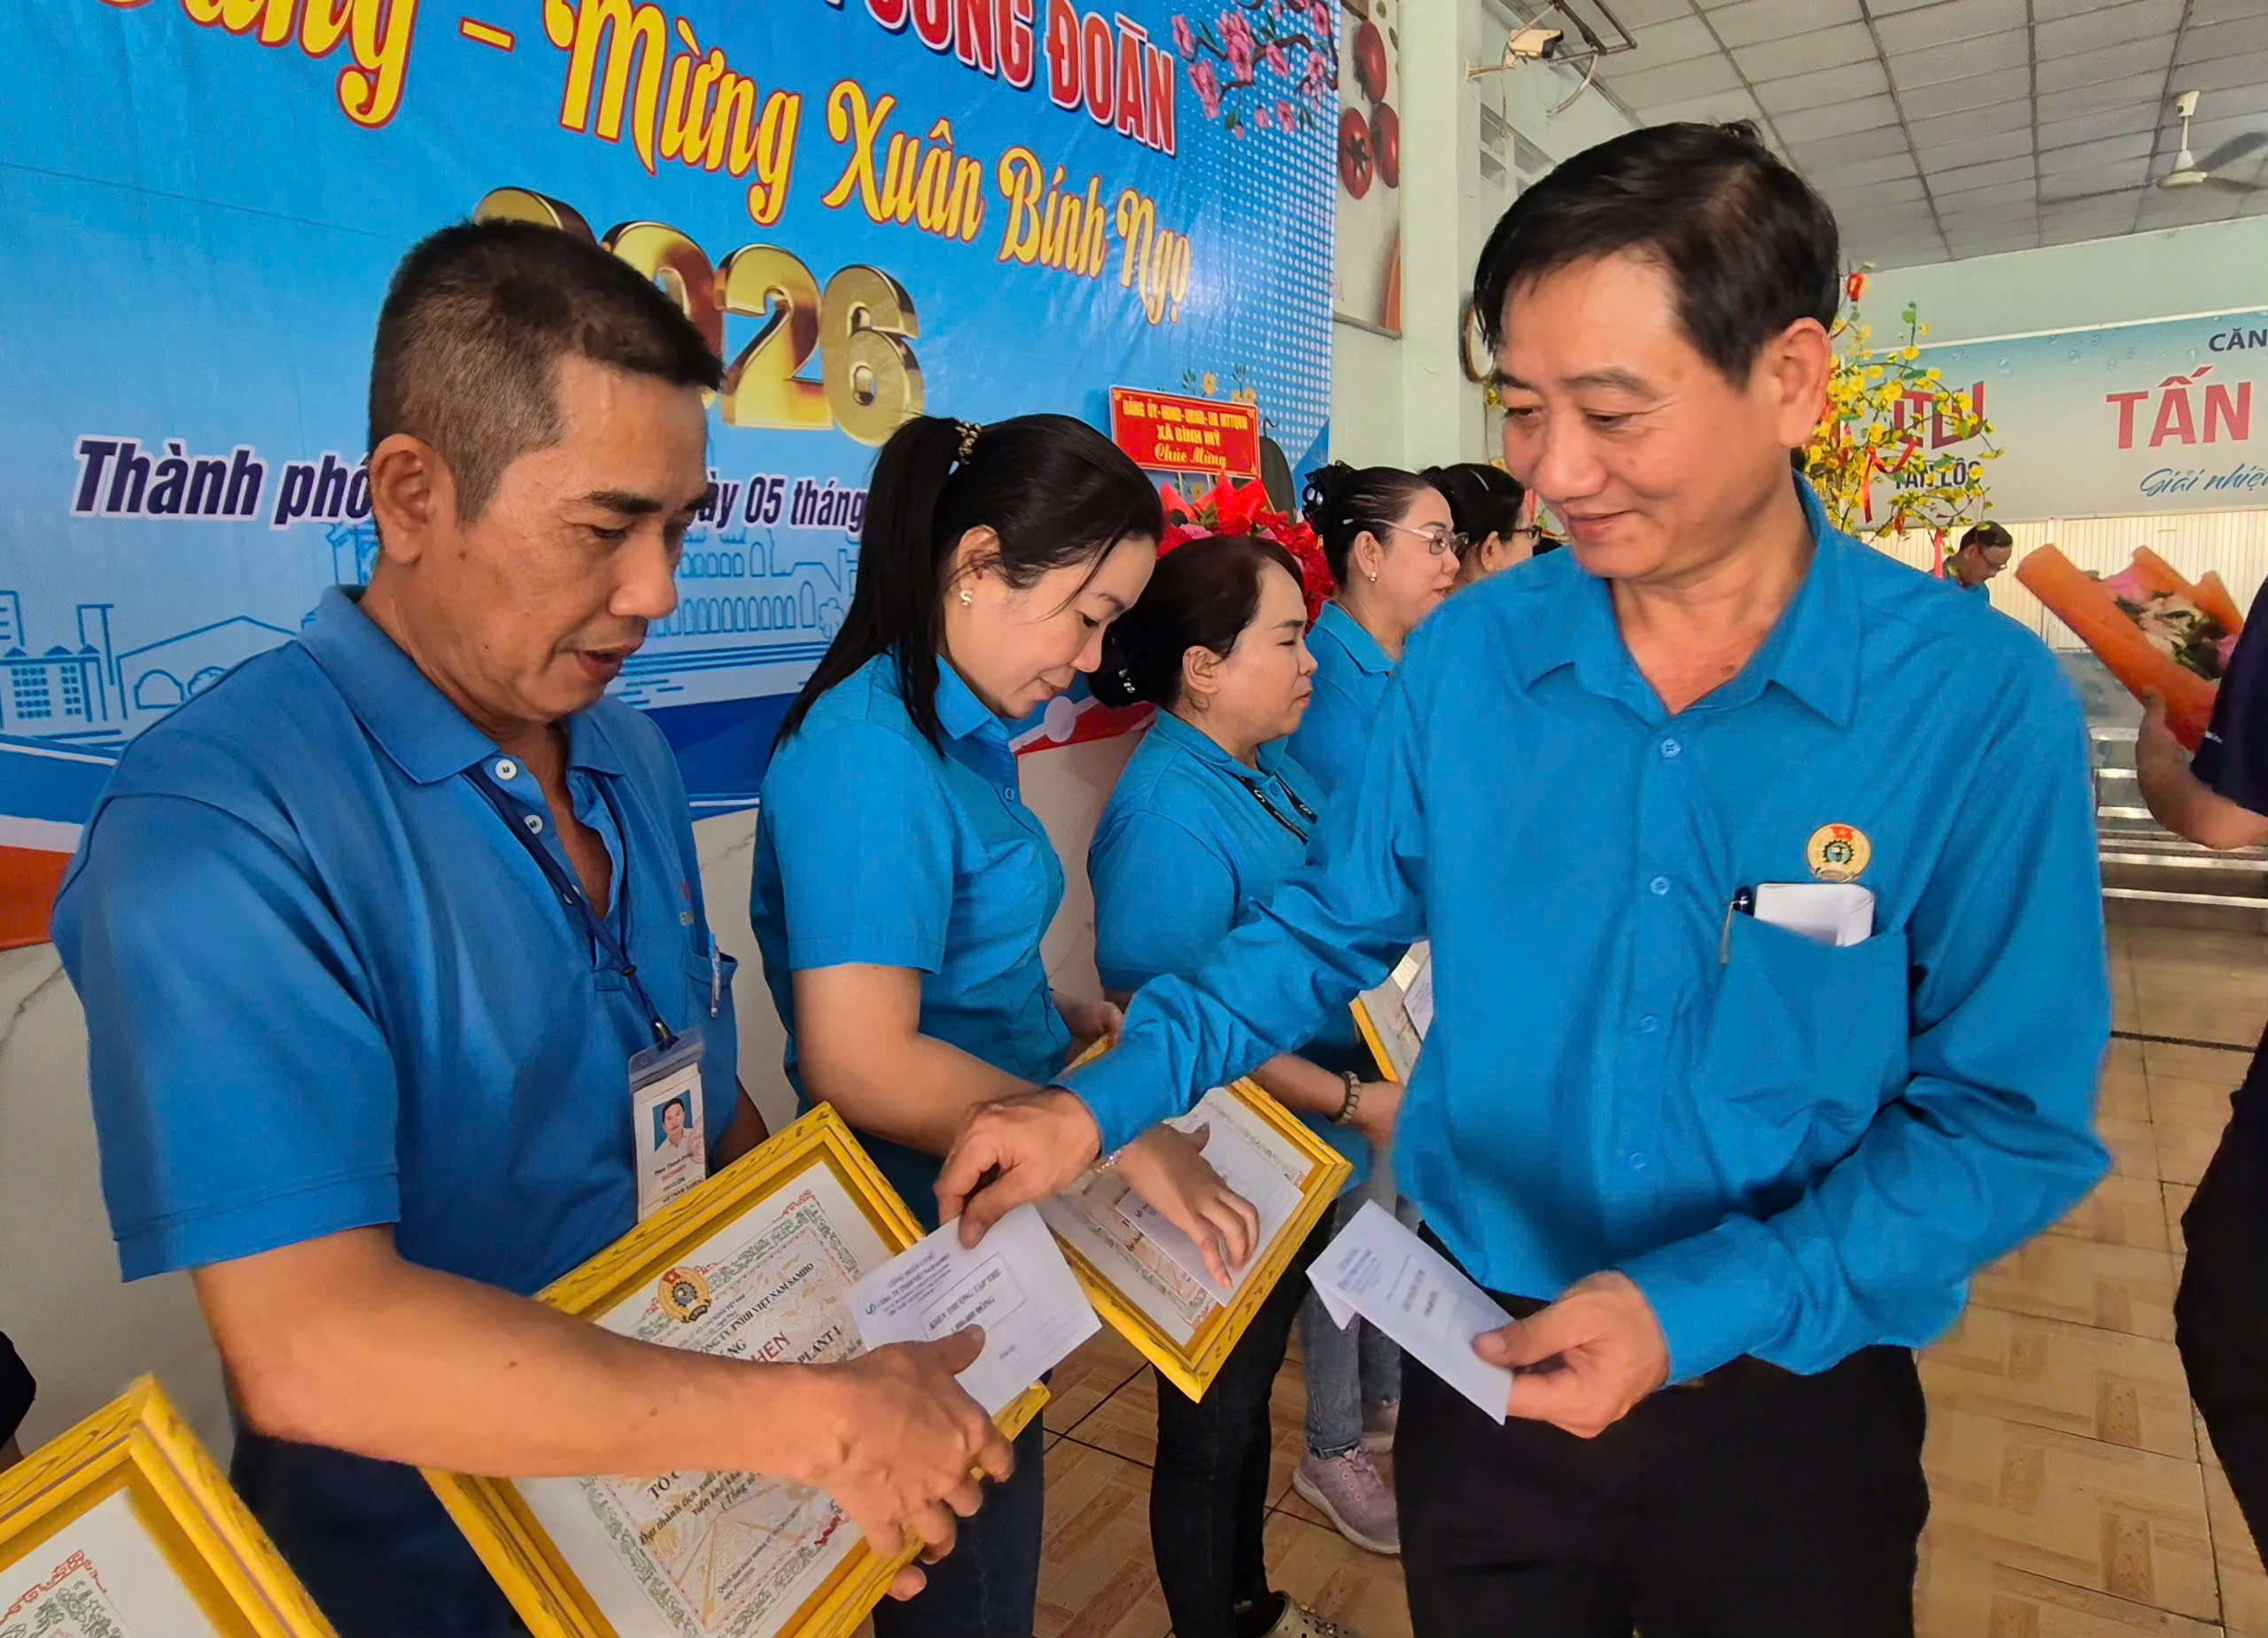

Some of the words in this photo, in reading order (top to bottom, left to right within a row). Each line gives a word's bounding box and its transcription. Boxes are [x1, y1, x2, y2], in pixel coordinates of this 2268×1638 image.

[1044, 0, 1177, 158] ĐOÀN
[543, 0, 802, 227] Mừng
[821, 79, 985, 243] Xuân
[998, 146, 1108, 279] Bính
[1116, 188, 1191, 326] Ngọ
[2208, 327, 2268, 353] CĂN
[2106, 365, 2252, 450] TẤN
[1175, 425, 1203, 444] BÌNH
[1154, 442, 1188, 462] Chúc
[74, 439, 265, 516] Thành
[745, 477, 785, 524] 05
[790, 479, 867, 532] tháng
[2140, 467, 2206, 497] Giải
[2203, 463, 2268, 492] nhiệ
[797, 1330, 834, 1363] PLANT
